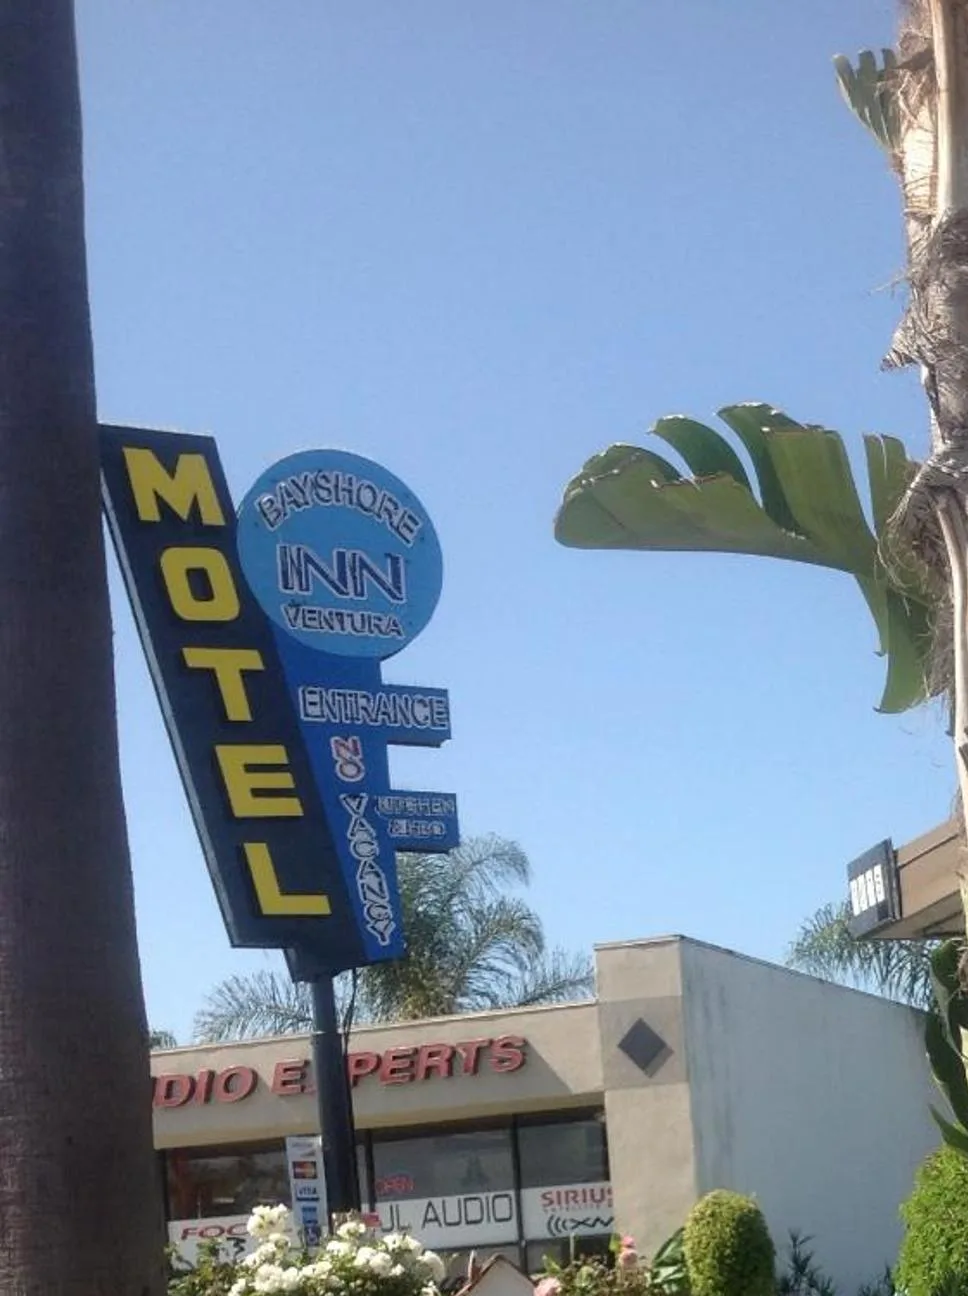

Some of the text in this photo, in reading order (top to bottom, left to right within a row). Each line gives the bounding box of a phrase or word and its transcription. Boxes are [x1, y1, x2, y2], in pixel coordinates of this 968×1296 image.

[257, 470, 421, 546] BAYSHORE
[277, 544, 406, 603] INN
[281, 602, 405, 639] VENTURA
[122, 447, 331, 916] MOTEL
[301, 686, 449, 728] ENTRANCE
[331, 736, 397, 945] NO VACANCY
[152, 1035, 529, 1109] DIO EPERTS
[380, 1194, 514, 1233] JL AUDIO
